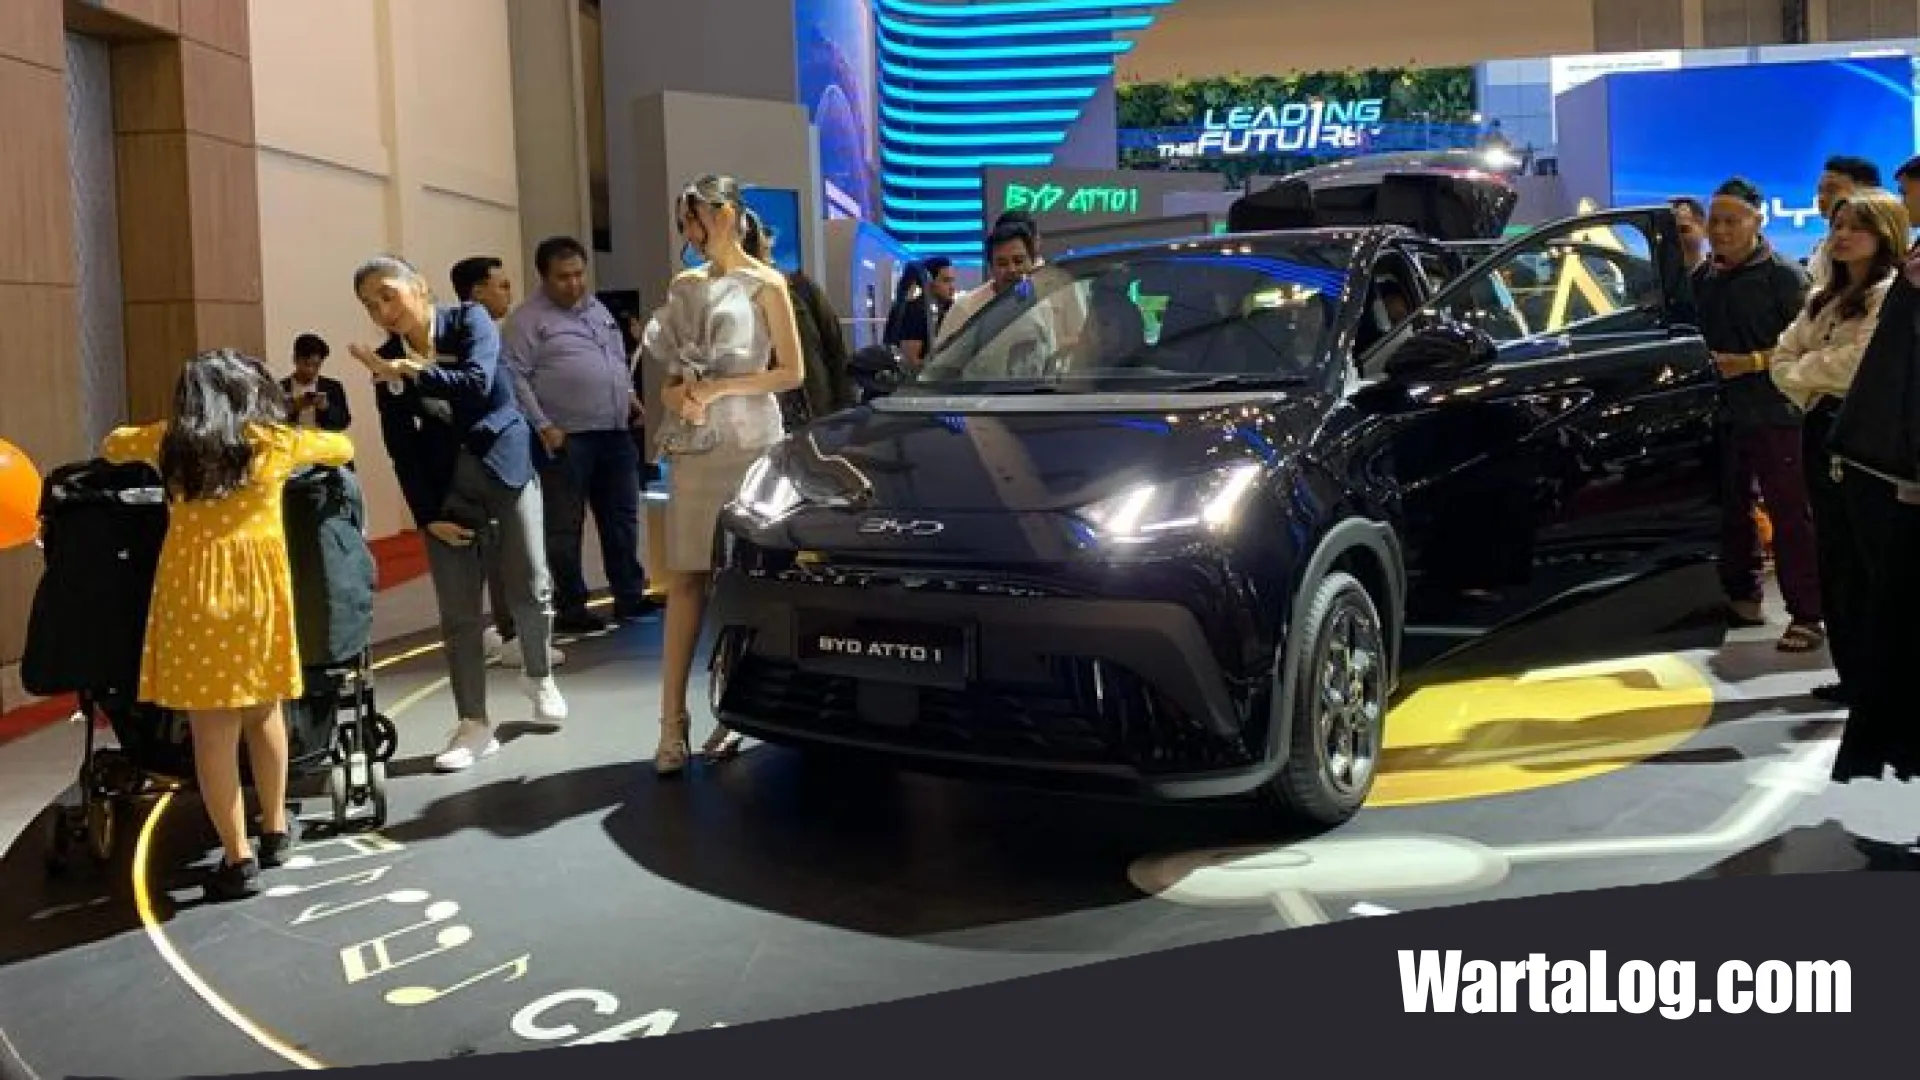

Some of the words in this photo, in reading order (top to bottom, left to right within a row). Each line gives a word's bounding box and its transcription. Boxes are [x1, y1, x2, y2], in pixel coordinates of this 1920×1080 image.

[1157, 142, 1198, 157] THE
[1006, 184, 1064, 214] BYD
[1067, 187, 1127, 214] ATTO
[858, 517, 945, 535] BYD
[819, 635, 862, 653] BYD
[867, 641, 927, 662] ATTO
[933, 649, 942, 664] 1
